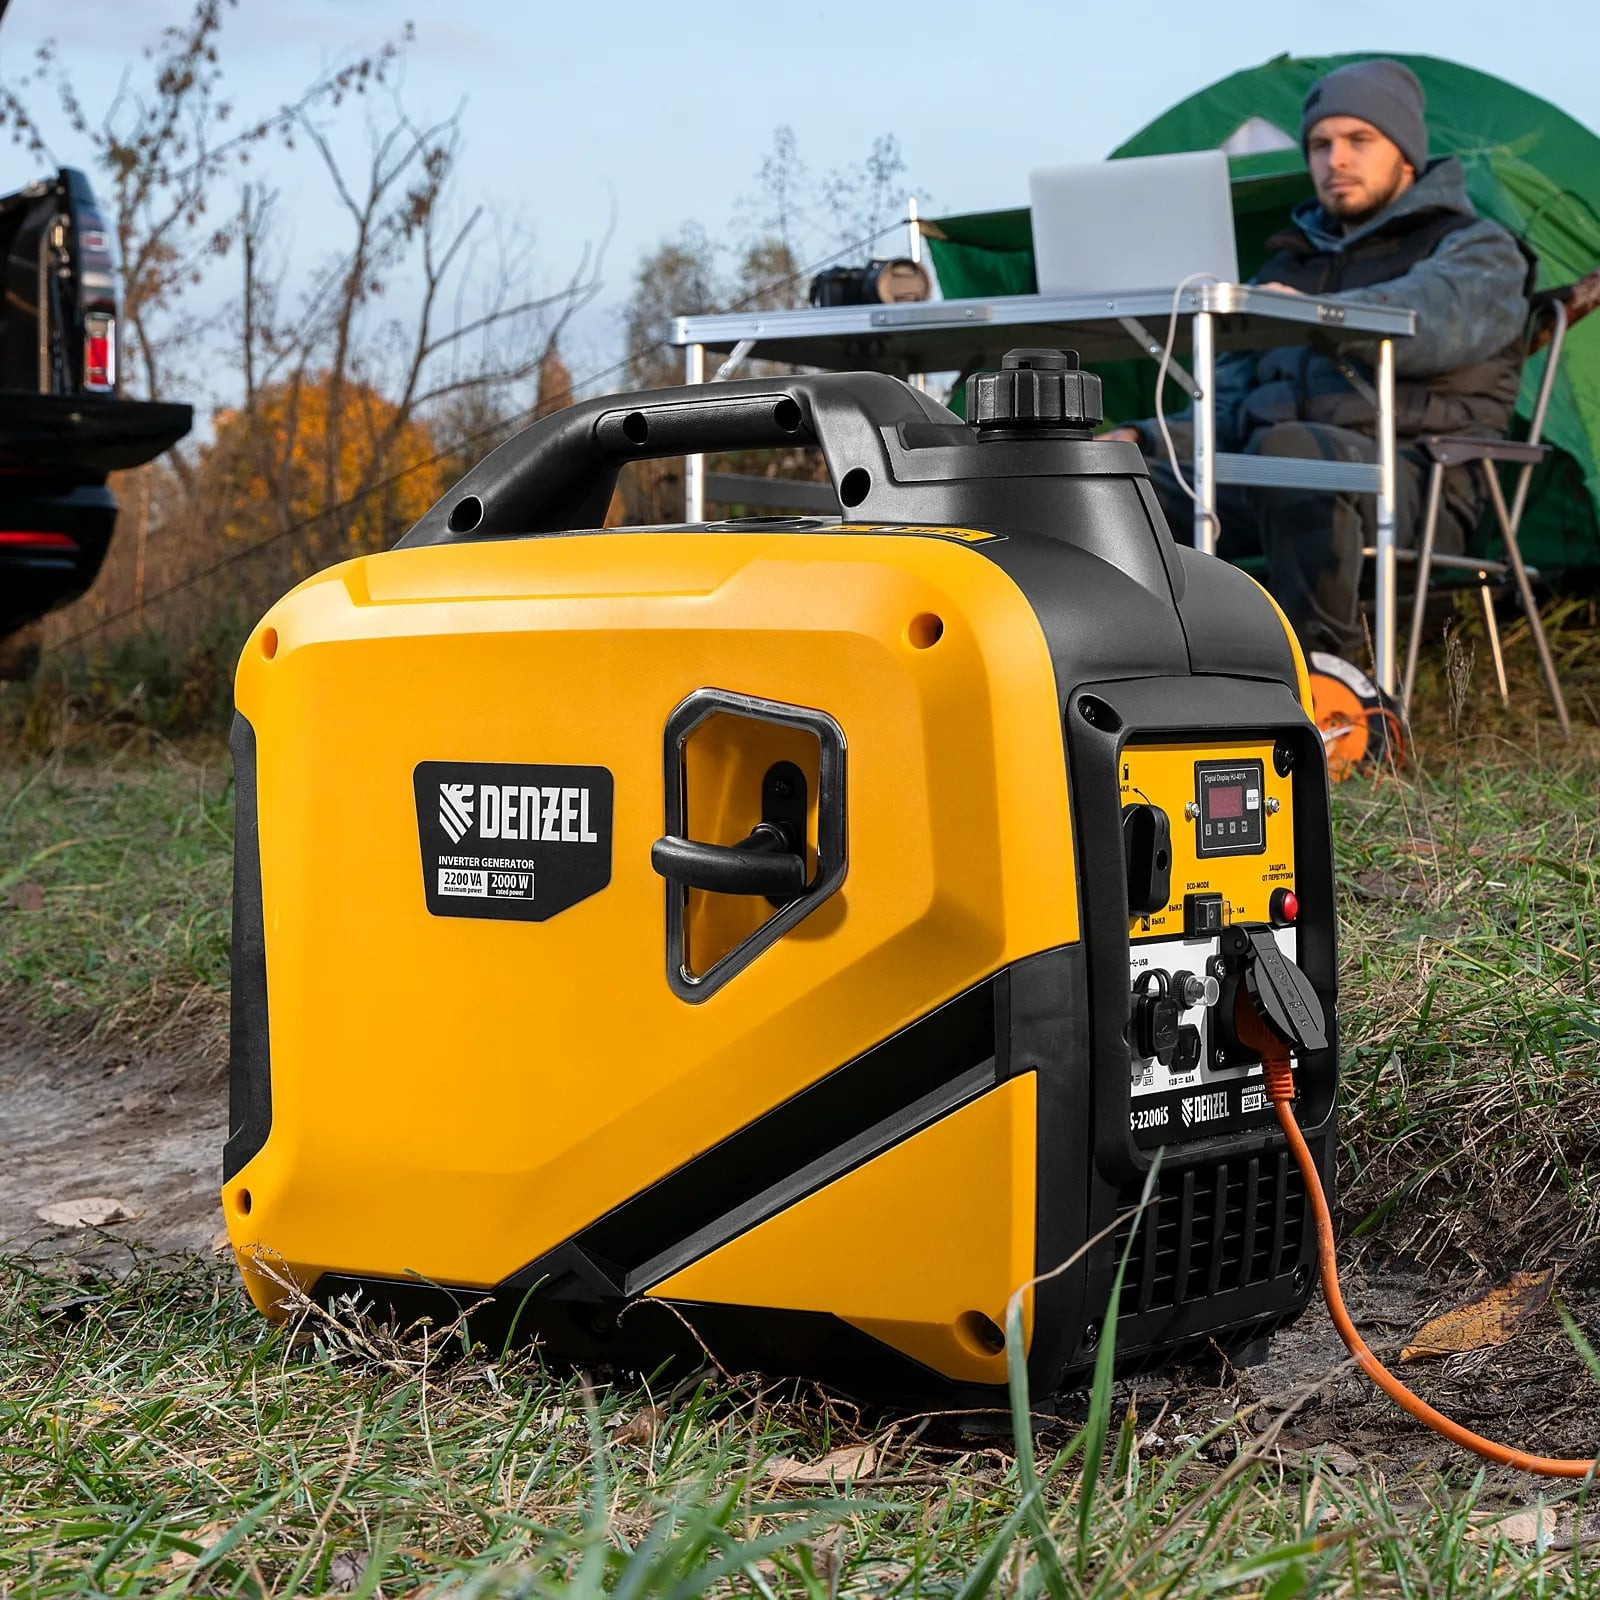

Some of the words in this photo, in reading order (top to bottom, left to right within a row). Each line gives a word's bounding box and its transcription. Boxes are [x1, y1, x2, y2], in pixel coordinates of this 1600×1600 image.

[1204, 774, 1216, 783] Digital
[1216, 773, 1230, 782] Display
[480, 785, 598, 843] DENZEL
[438, 855, 480, 867] INVERTER
[481, 857, 535, 869] GENERATOR
[1269, 863, 1287, 871] ЗАЩИТА
[444, 872, 469, 886] 2200
[470, 872, 482, 887] VA
[491, 874, 517, 889] 2000
[519, 875, 529, 889] W
[1261, 874, 1268, 882] ОТ
[1186, 881, 1210, 890] ECO-MODE
[1168, 903, 1182, 912] ВЫКЛ
[1151, 917, 1166, 925] ВЫКЛ
[1138, 958, 1149, 967] USB
[1194, 1091, 1230, 1123] DENZEL
